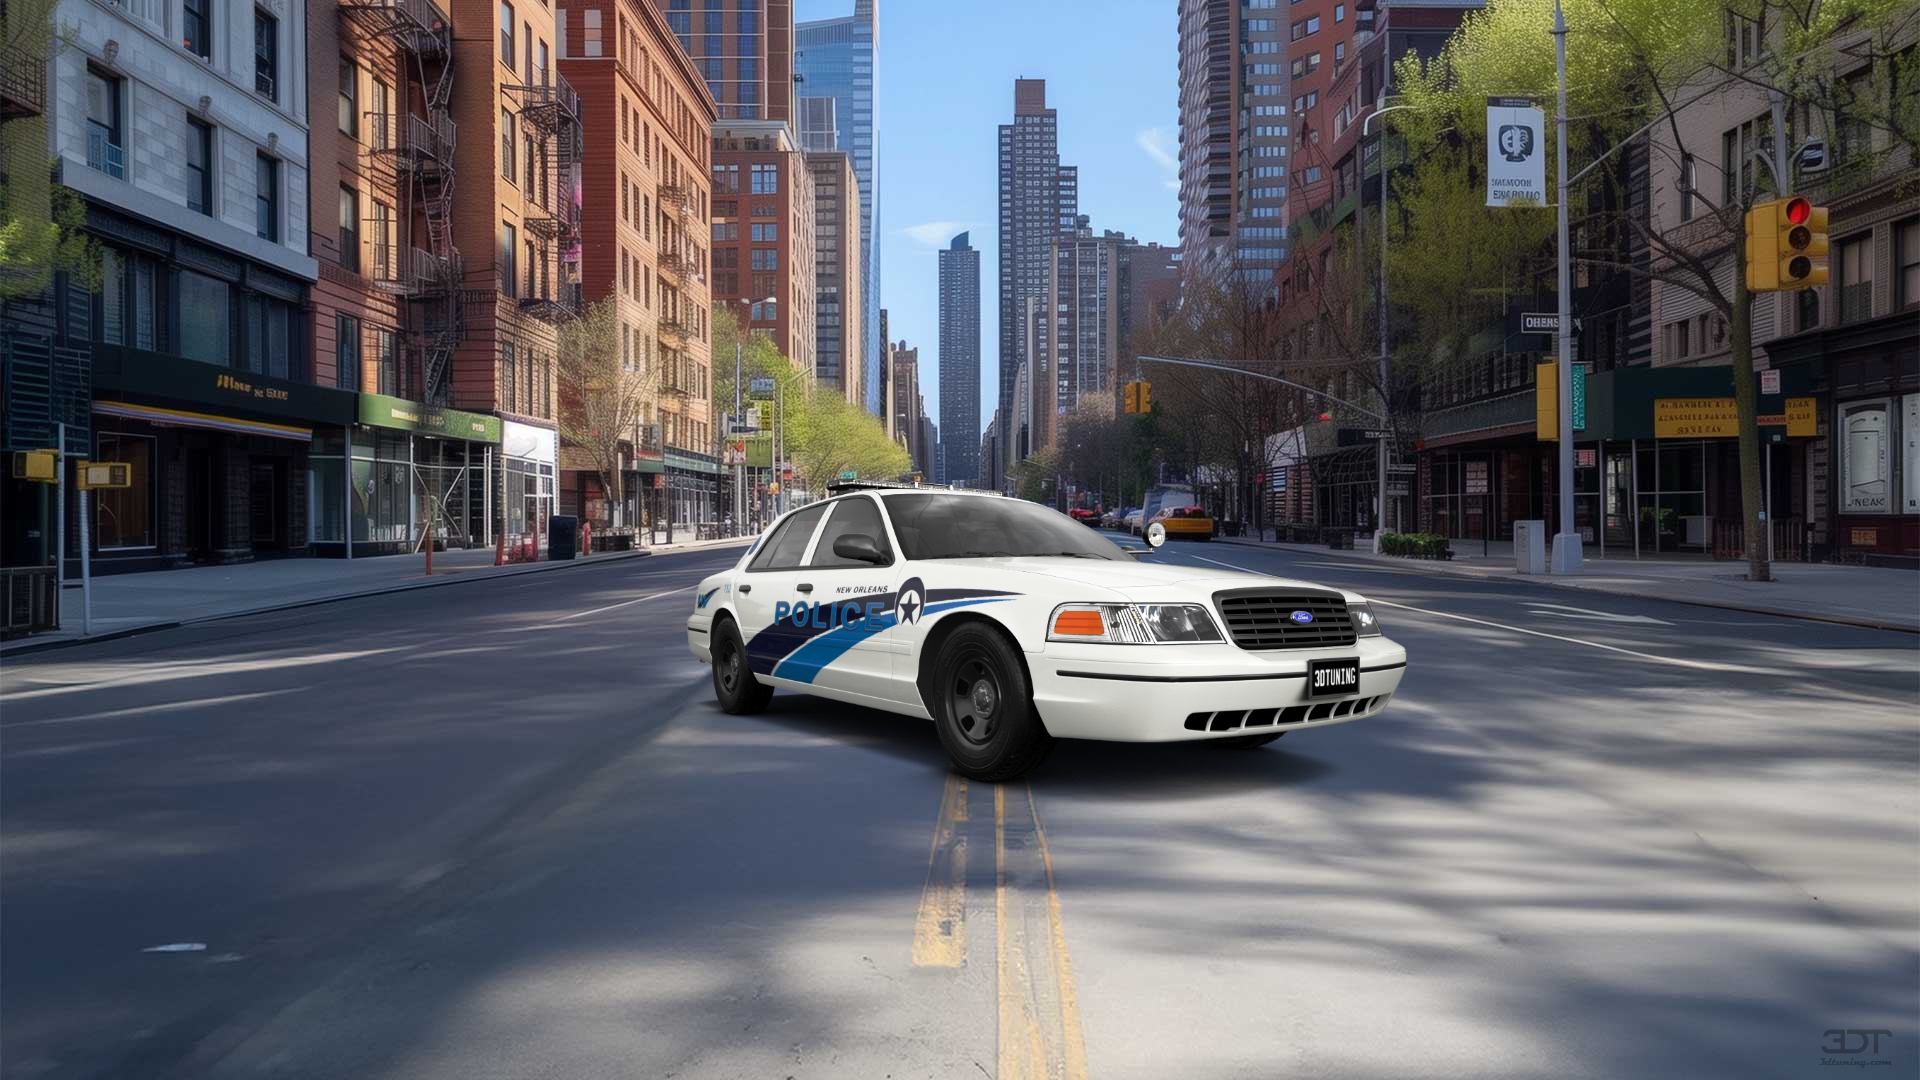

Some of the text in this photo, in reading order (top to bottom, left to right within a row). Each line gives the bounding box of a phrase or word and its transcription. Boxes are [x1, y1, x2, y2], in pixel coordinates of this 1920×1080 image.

[835, 585, 889, 594] NEW ORLEANS
[774, 600, 885, 632] POLICE
[1314, 667, 1356, 687] 3DTUNING
